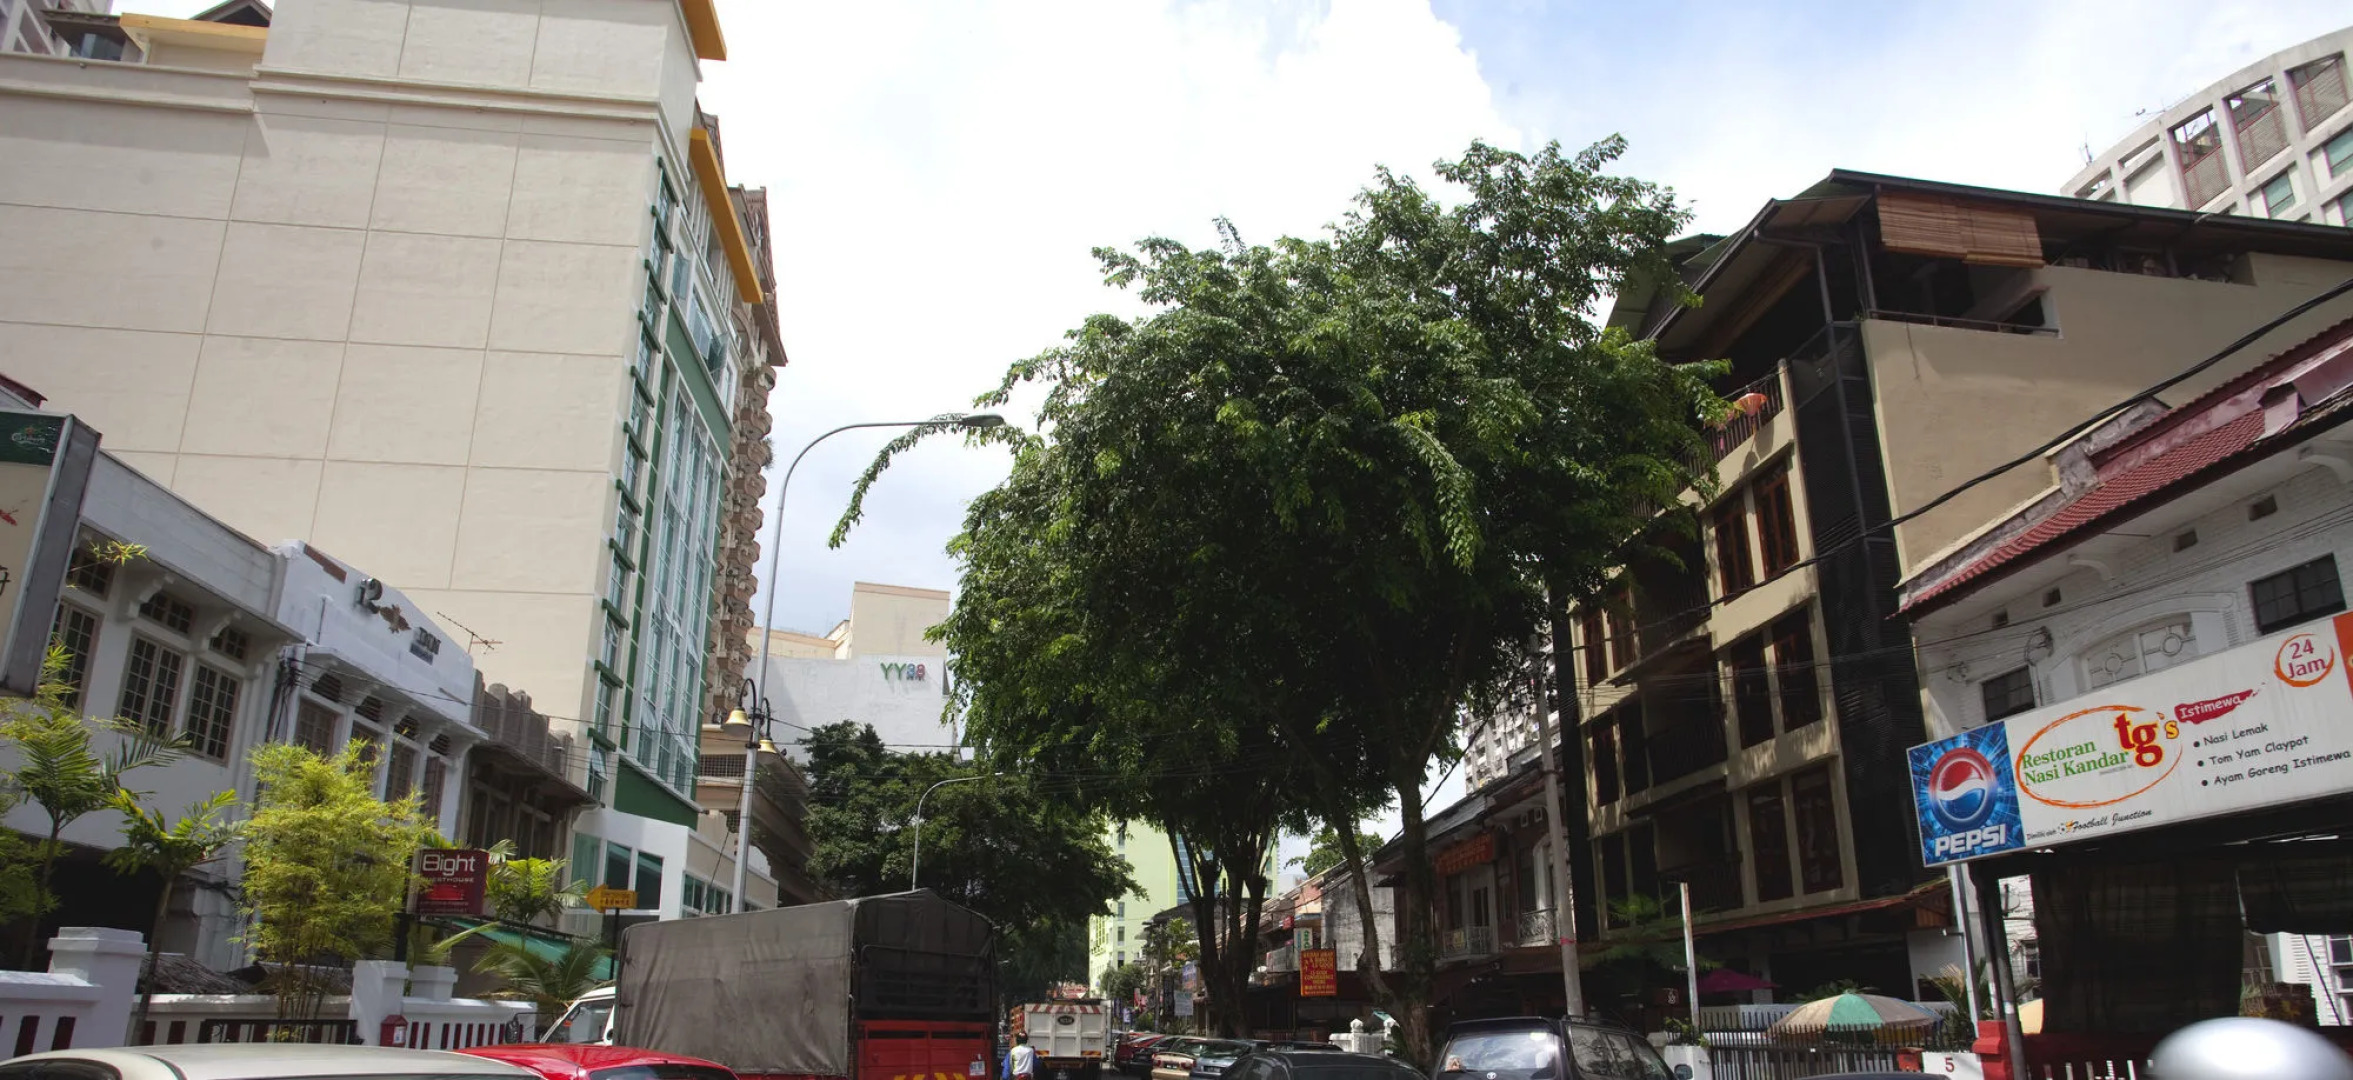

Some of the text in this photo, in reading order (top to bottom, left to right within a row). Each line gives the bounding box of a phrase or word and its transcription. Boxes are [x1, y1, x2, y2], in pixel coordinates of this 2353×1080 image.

[2289, 639, 2315, 660] 24
[2287, 658, 2327, 679] Jam
[2179, 695, 2242, 719] Istimewa
[2203, 723, 2269, 747] Nasi Lemak
[2022, 741, 2096, 769] Restoran
[2208, 735, 2309, 766] Tom Yam Claypot
[2024, 765, 2060, 785] Nasi
[2064, 750, 2130, 777] Kandar
[2213, 749, 2351, 786] Ayam Goreng Istimewa
[2071, 809, 2153, 833] Football Junction
[1935, 823, 2006, 857] PEPSI
[1945, 1057, 1955, 1073] 5
